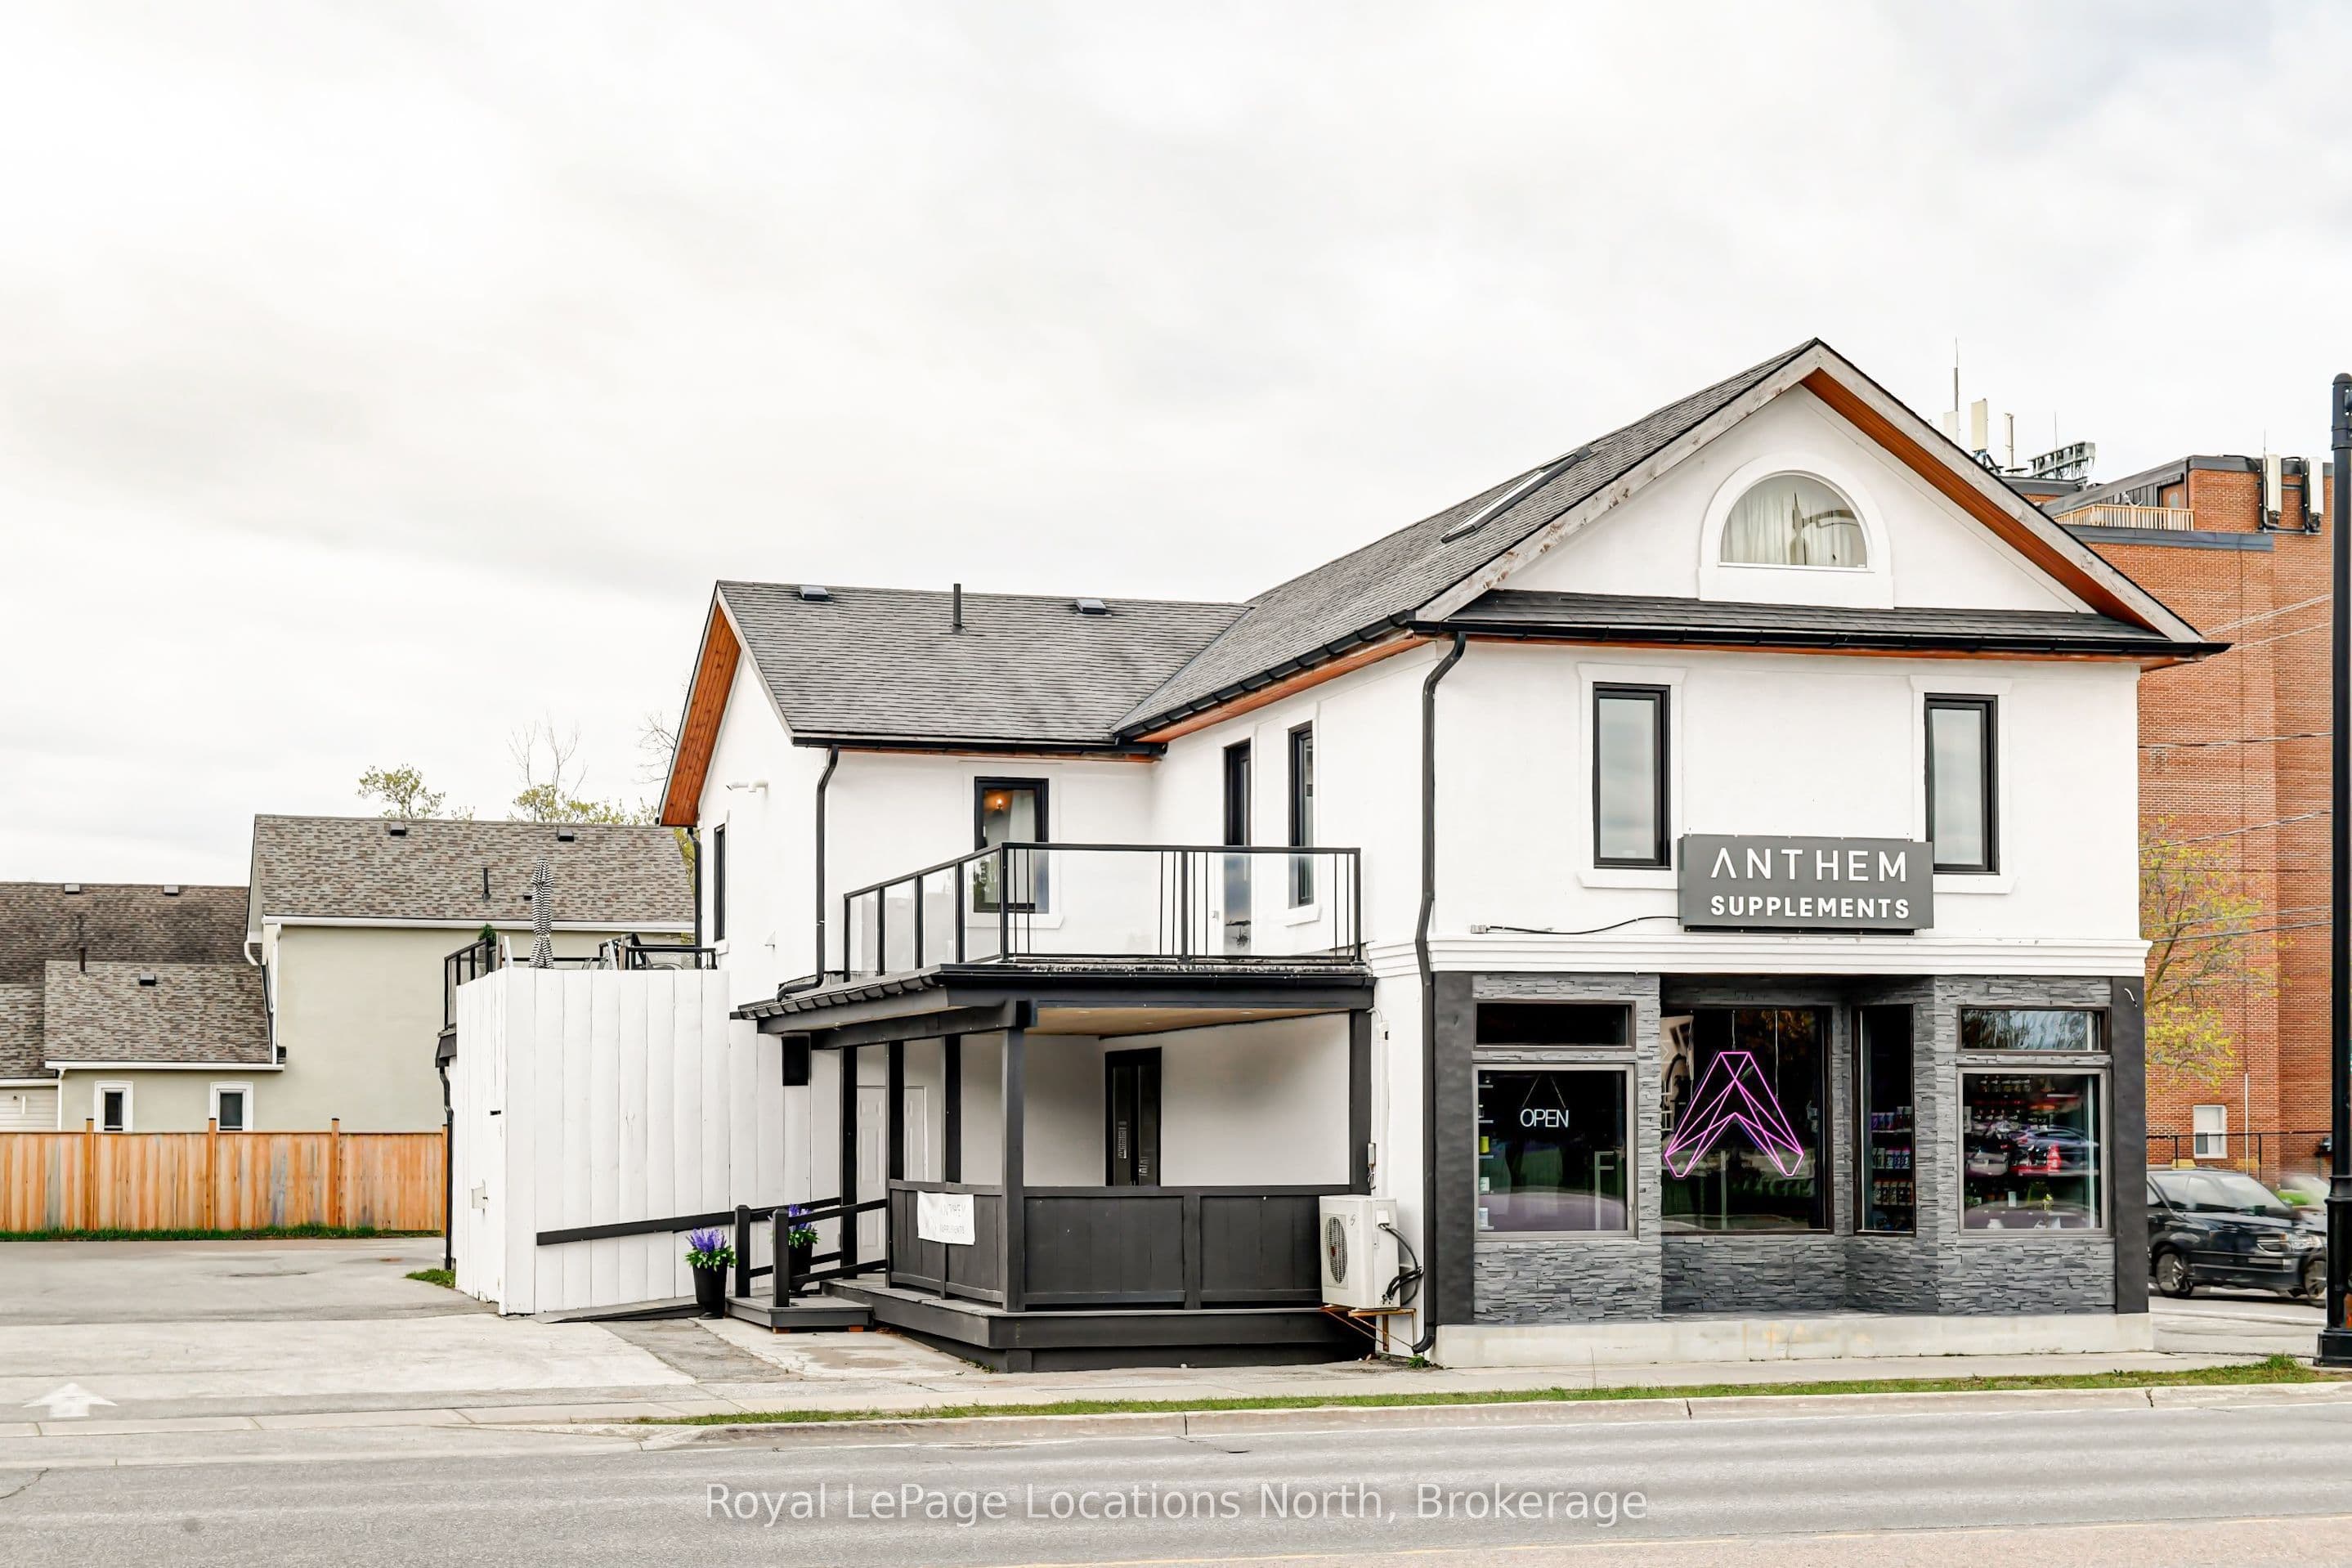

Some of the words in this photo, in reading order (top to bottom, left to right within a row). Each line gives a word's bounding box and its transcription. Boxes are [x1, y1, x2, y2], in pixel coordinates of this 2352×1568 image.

[1711, 847, 1906, 881] ANTHEM
[1710, 895, 1910, 919] SUPPLEMENTS
[1521, 1109, 1569, 1127] OPEN
